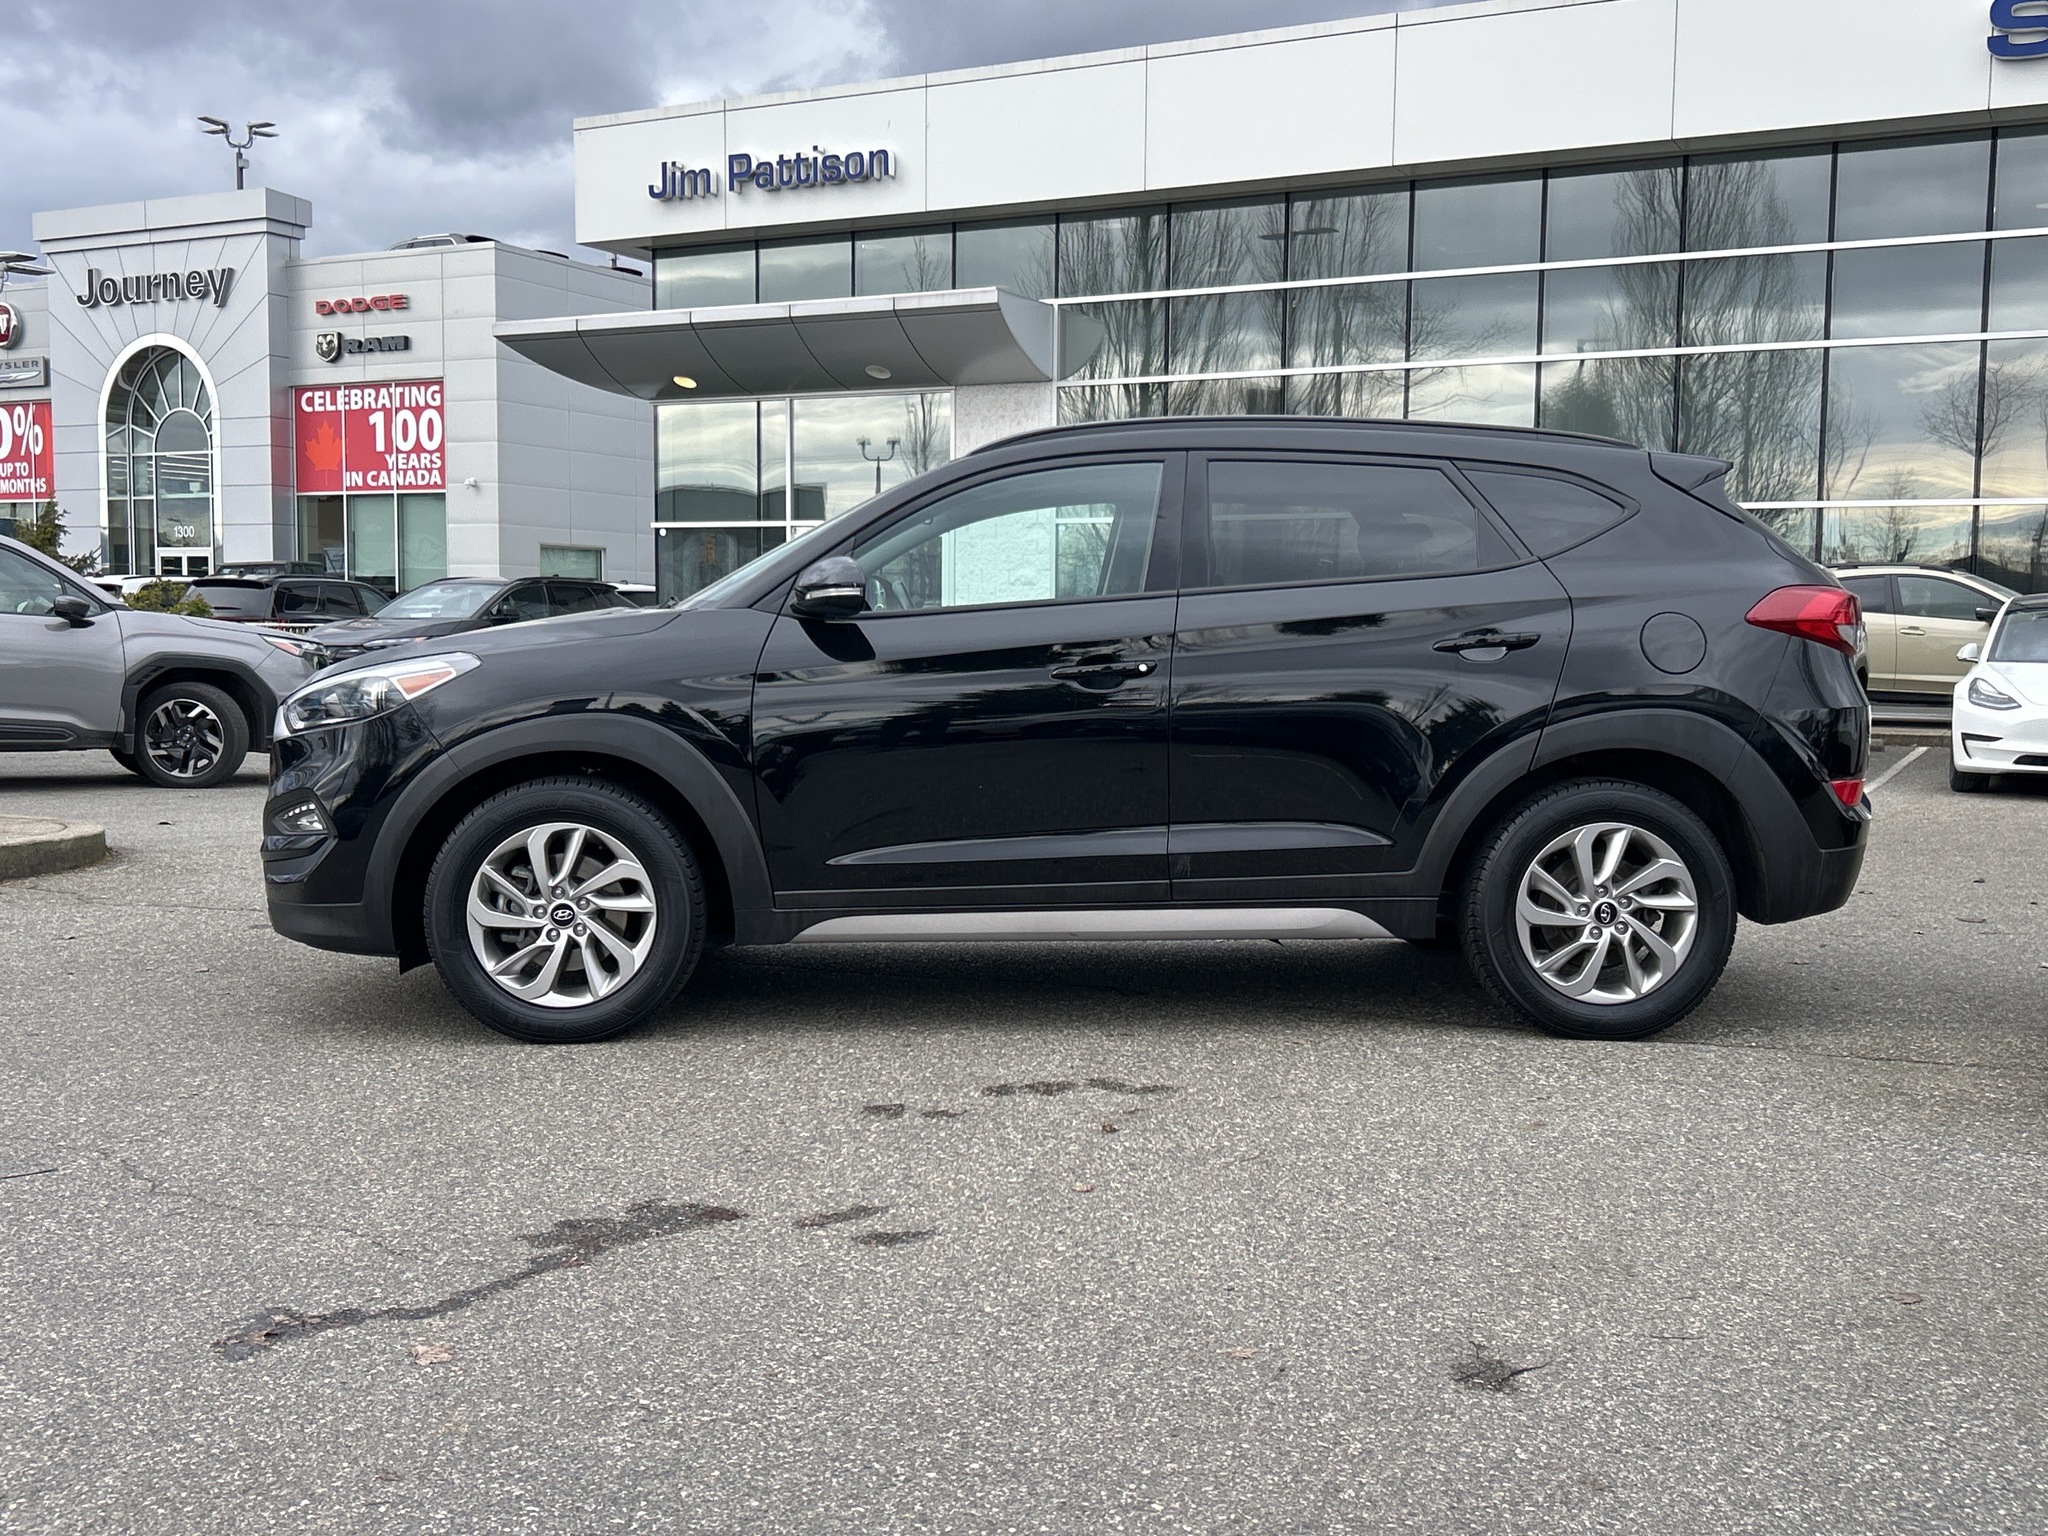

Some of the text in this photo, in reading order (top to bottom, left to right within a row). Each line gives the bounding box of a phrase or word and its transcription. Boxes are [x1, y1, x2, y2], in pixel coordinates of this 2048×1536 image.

[648, 145, 896, 201] Jim Pattison
[76, 266, 234, 308] Journey
[315, 294, 409, 315] DODGE
[341, 335, 410, 353] RAM
[300, 385, 442, 412] CELEBRATING
[368, 408, 443, 452] 100
[0, 462, 29, 477] UP TO
[384, 453, 442, 470] YEARS
[0, 477, 47, 494] MONTHS
[345, 469, 442, 487] IN CANADA
[173, 525, 195, 538] 1300
